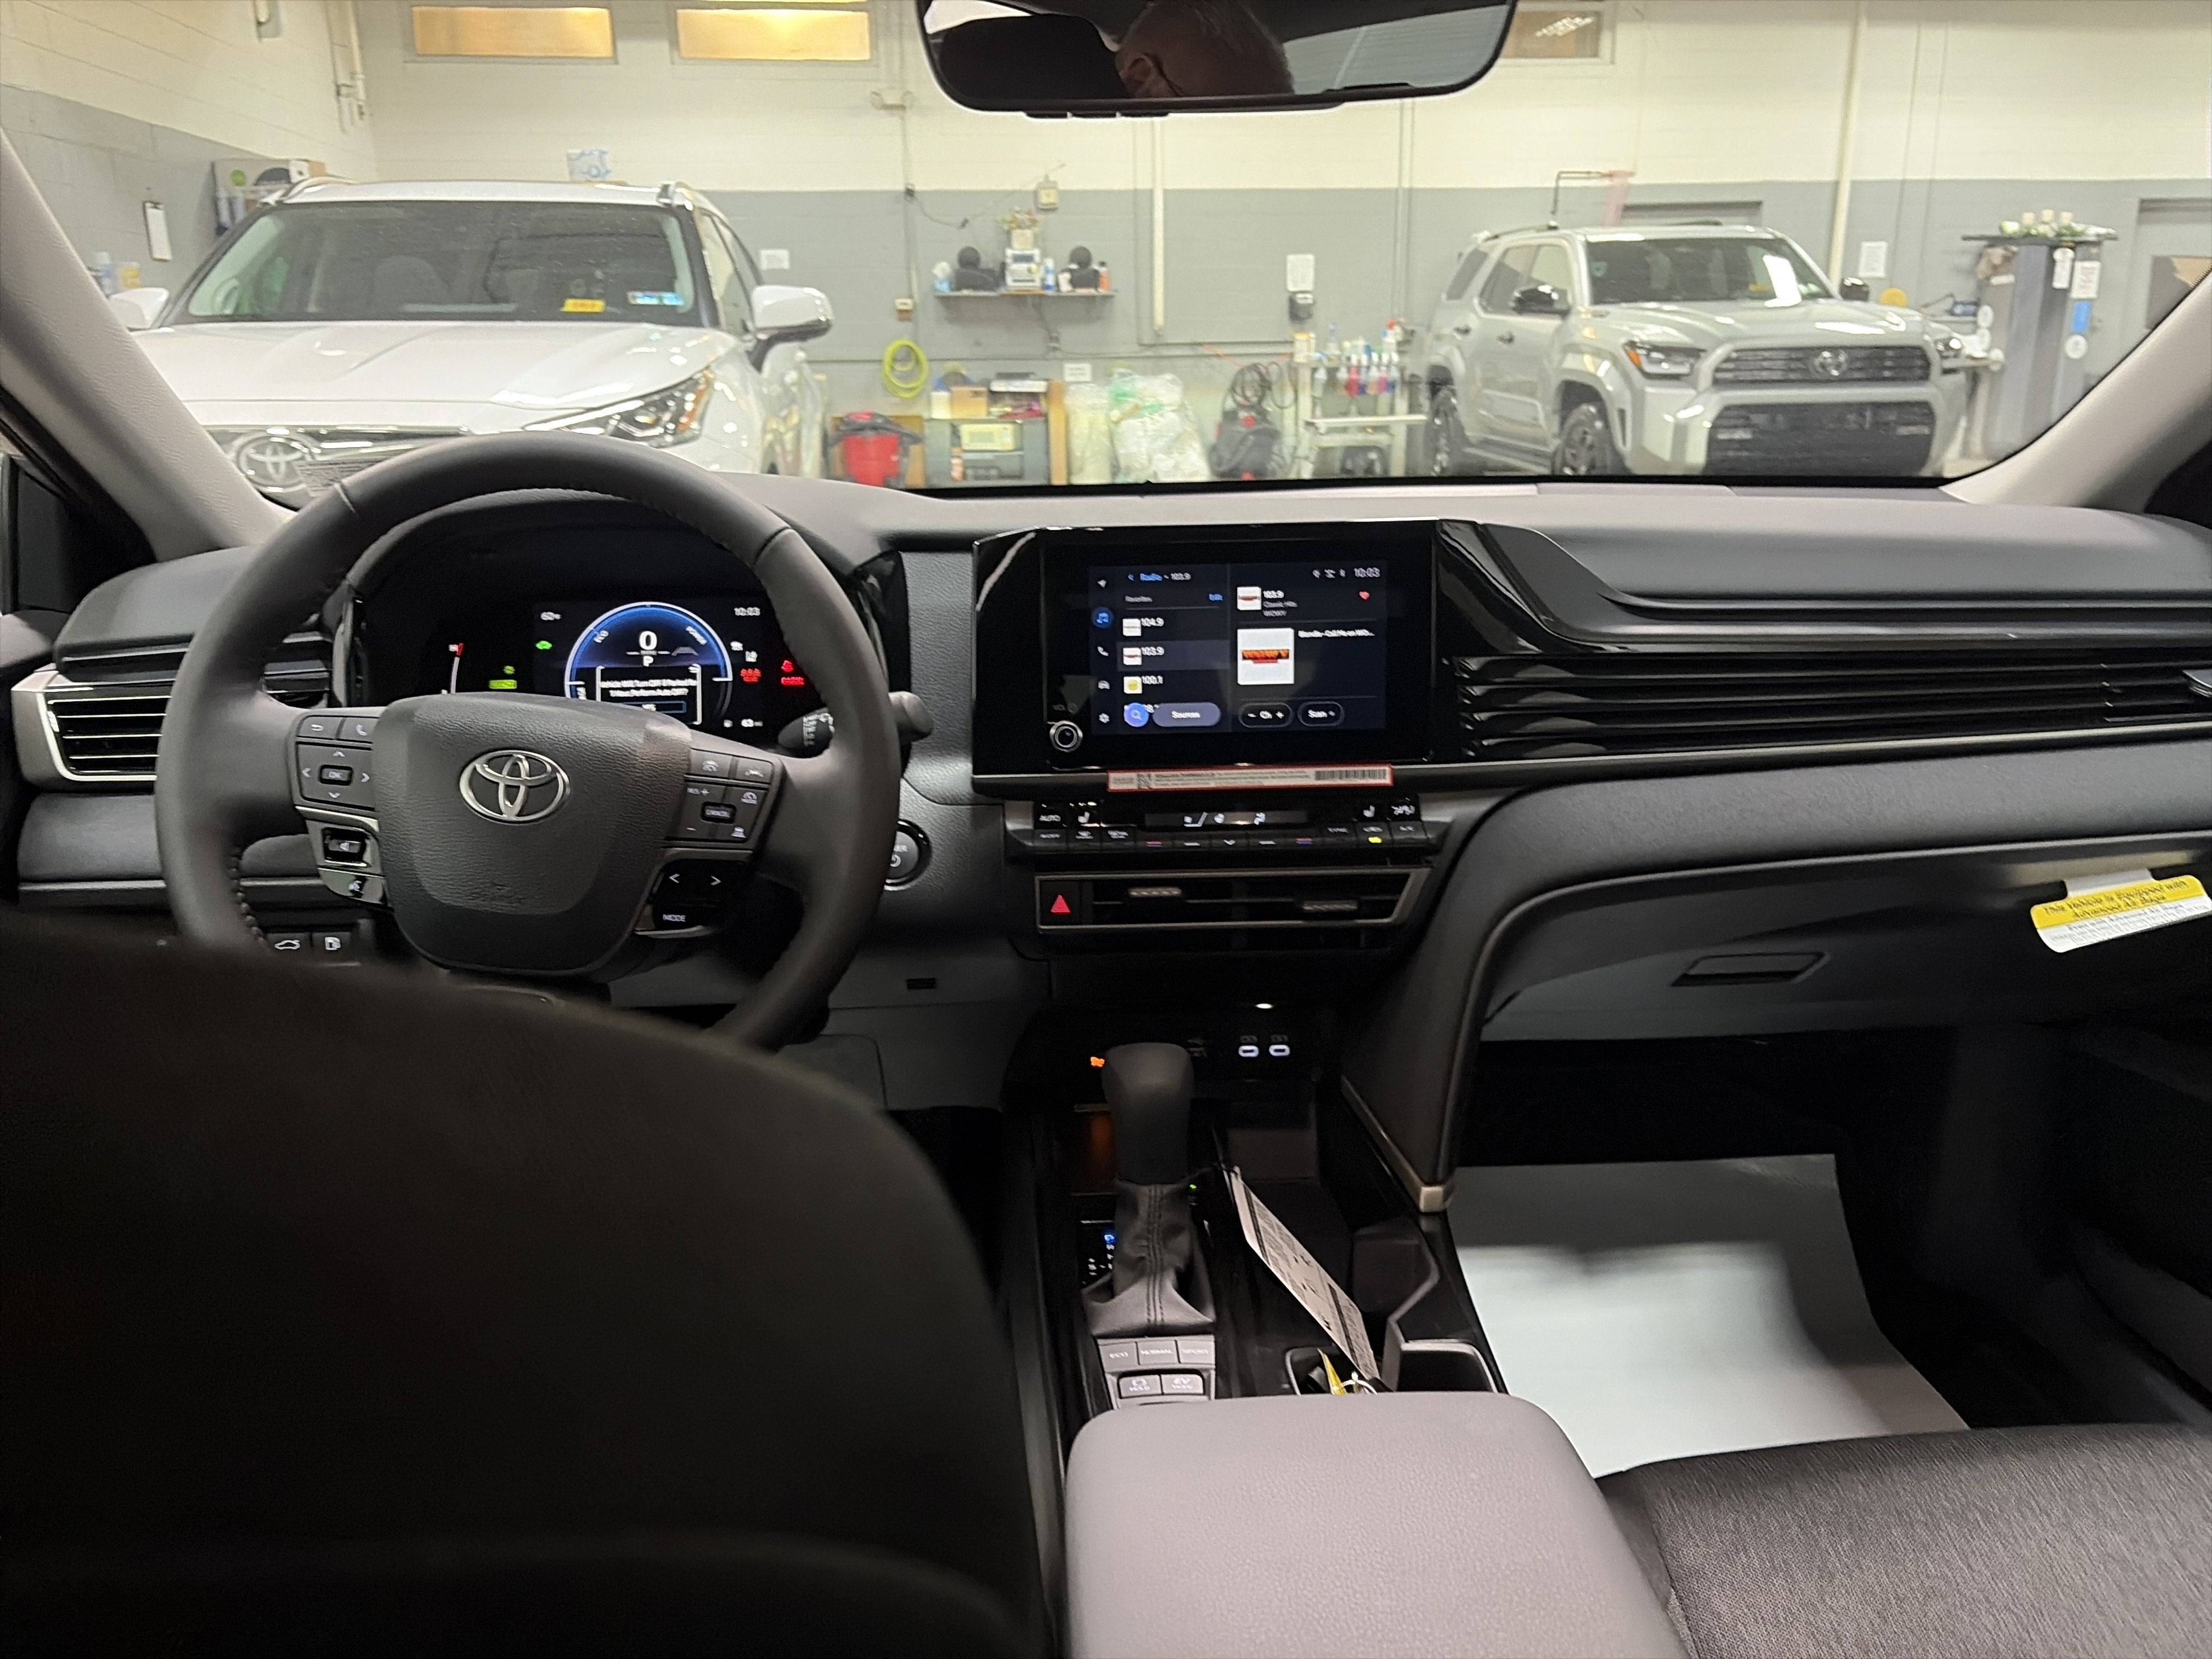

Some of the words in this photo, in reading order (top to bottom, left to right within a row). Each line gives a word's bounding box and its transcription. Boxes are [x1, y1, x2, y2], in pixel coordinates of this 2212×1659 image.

[1353, 567, 1380, 578] 10:03
[1263, 590, 1284, 599] 103.9
[639, 631, 657, 650] 0
[1141, 646, 1165, 656] 103.9
[643, 656, 654, 667] P
[662, 913, 686, 923] MODE
